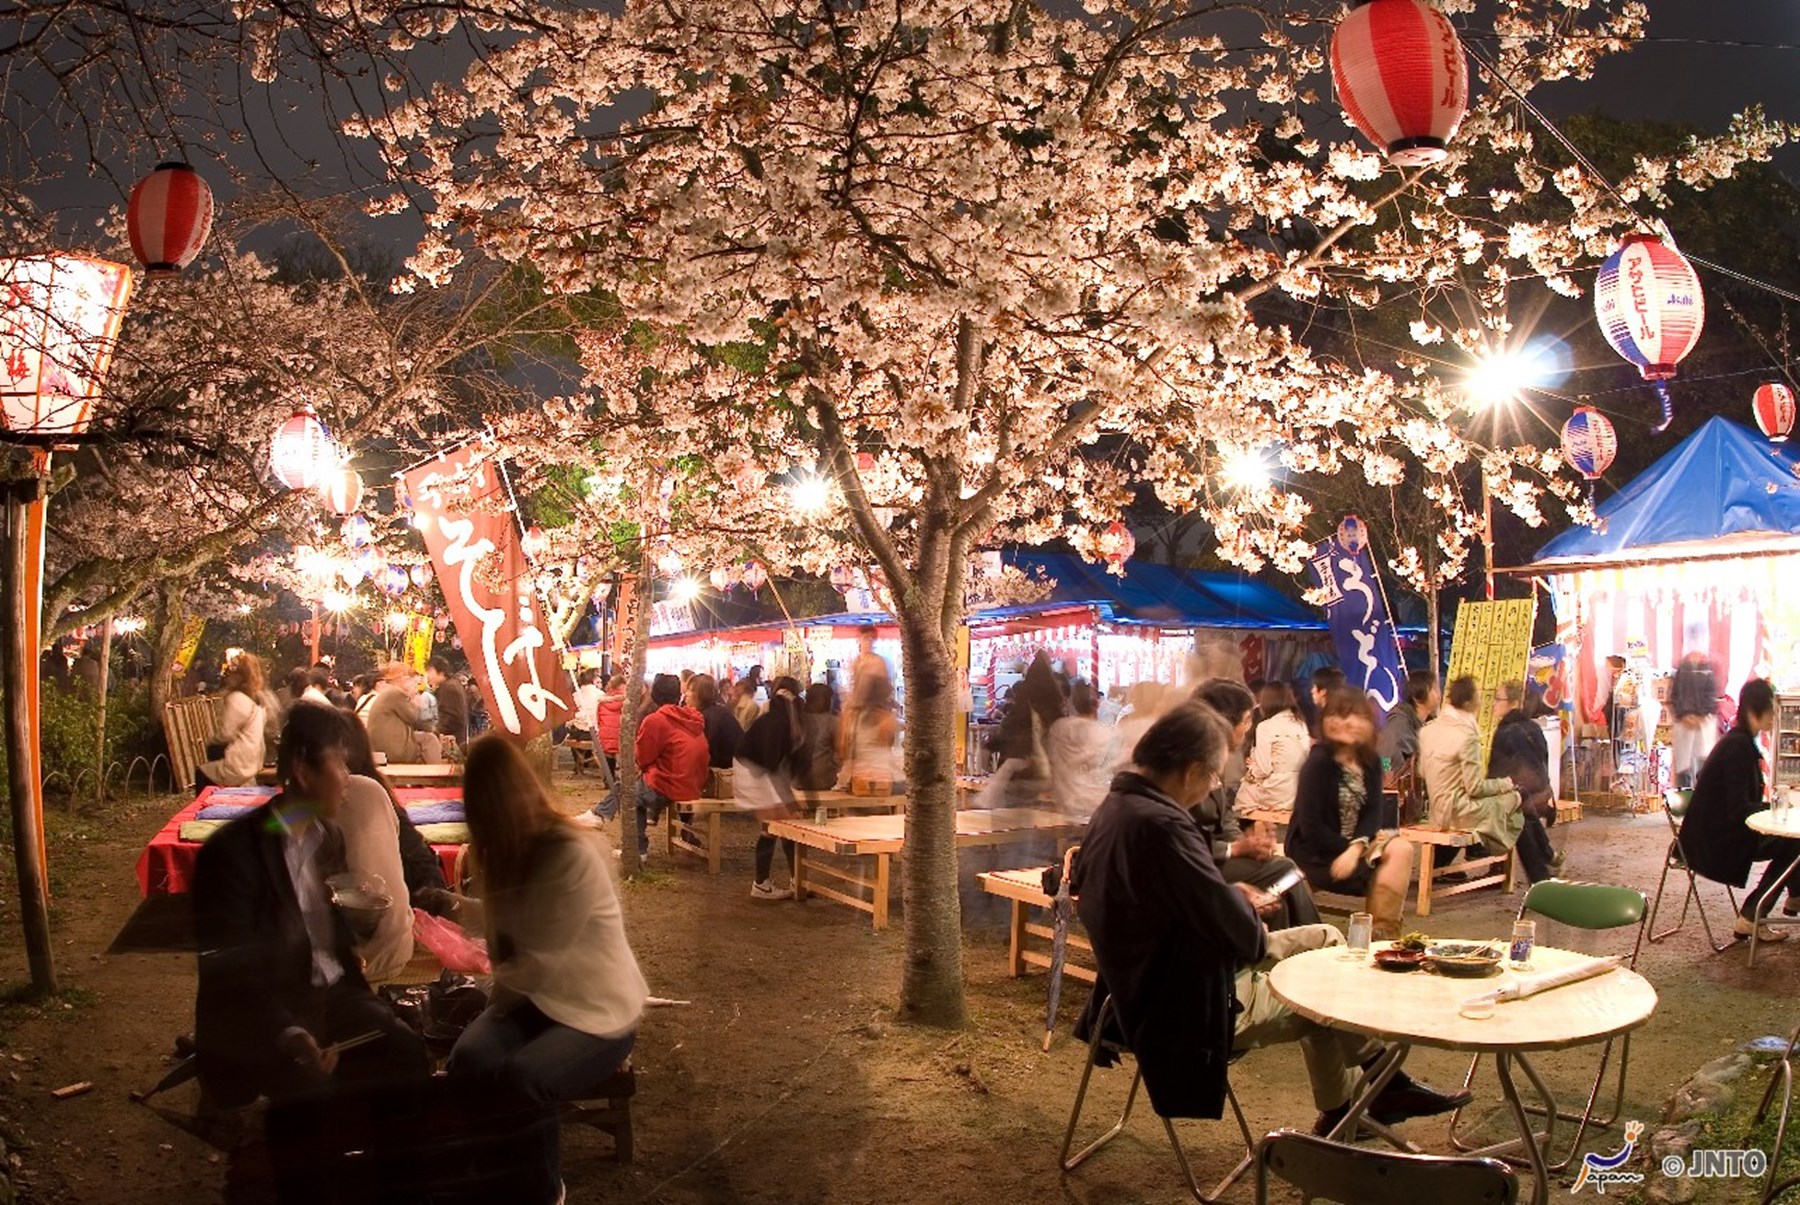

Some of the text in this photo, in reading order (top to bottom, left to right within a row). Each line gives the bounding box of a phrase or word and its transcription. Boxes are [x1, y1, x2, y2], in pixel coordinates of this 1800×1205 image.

[1628, 257, 1655, 339] アサヒビール
[438, 516, 569, 735] そば
[1338, 558, 1399, 712] うどん
